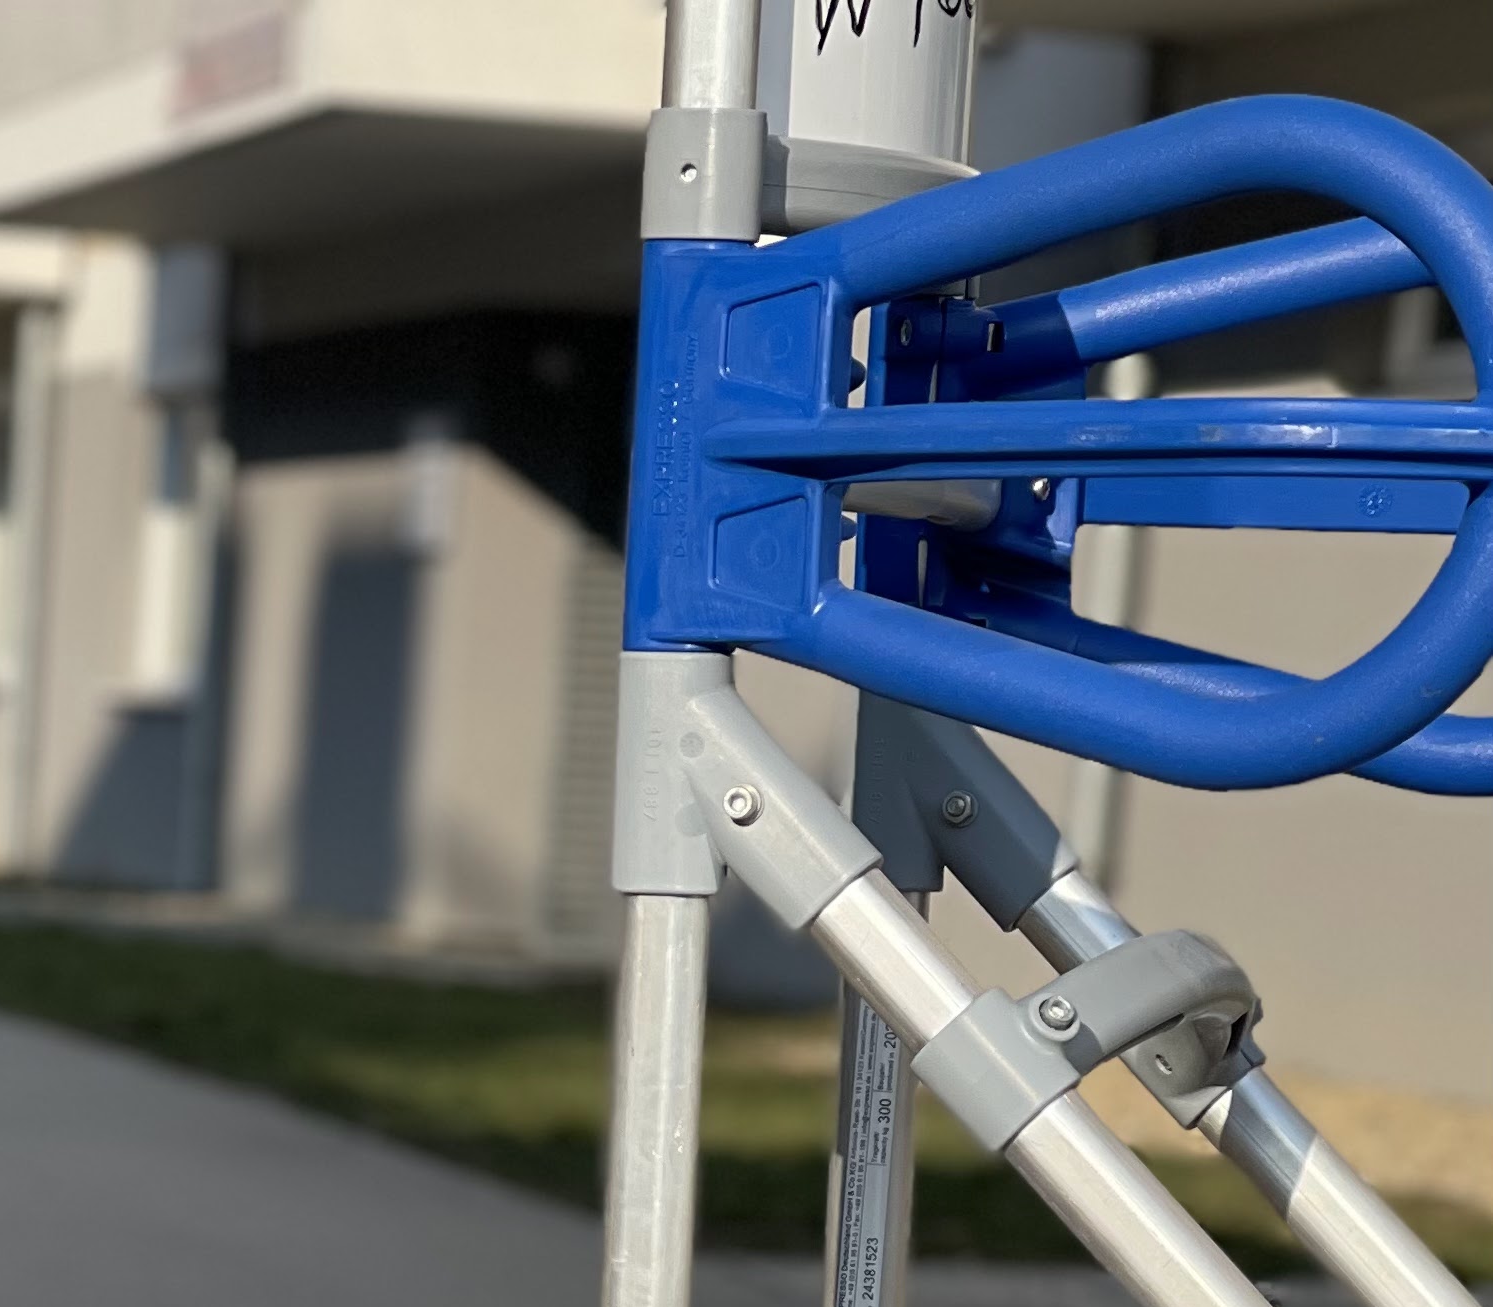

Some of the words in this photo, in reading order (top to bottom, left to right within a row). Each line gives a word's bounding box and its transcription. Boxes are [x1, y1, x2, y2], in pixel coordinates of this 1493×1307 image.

[652, 380, 678, 516] EXPRESSO
[877, 1099, 891, 1123] 300
[849, 1161, 857, 1175] KG
[862, 1238, 878, 1300] 24381523
